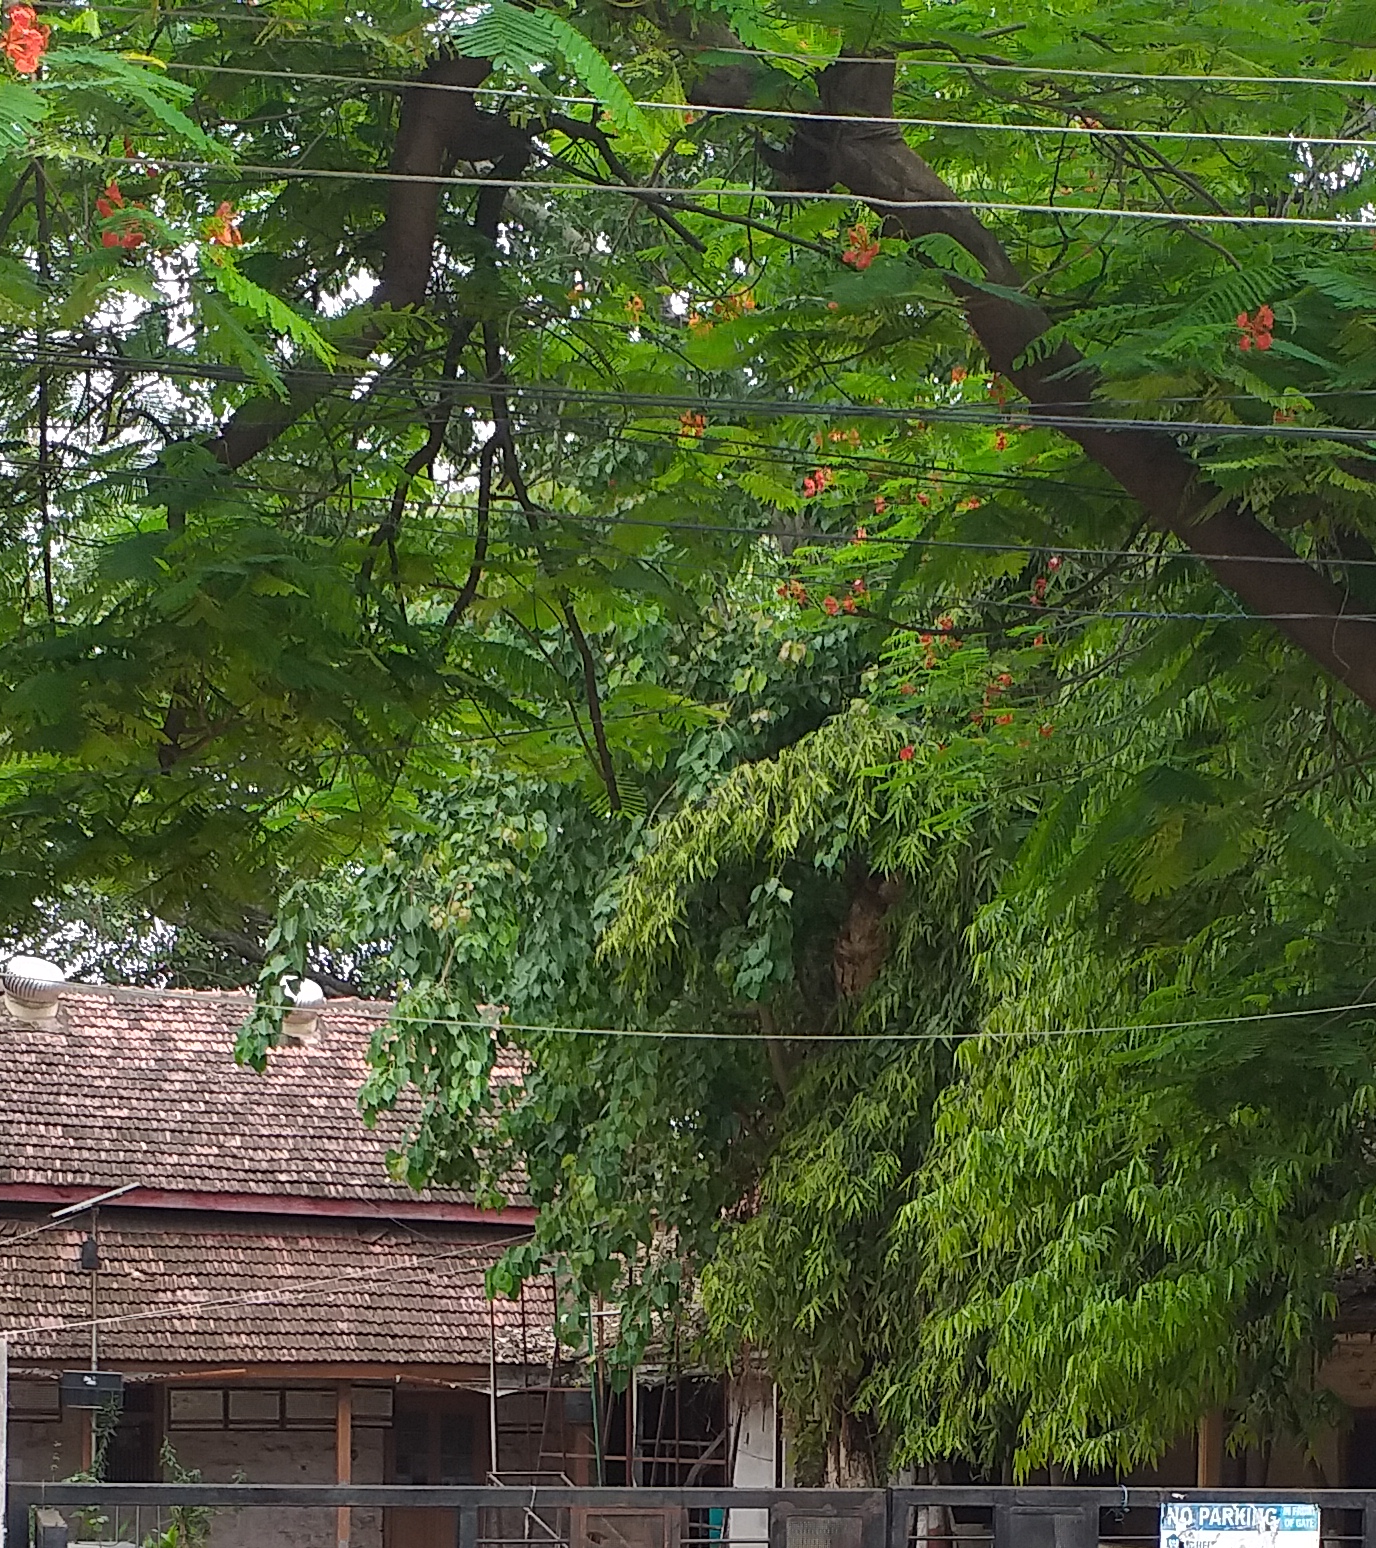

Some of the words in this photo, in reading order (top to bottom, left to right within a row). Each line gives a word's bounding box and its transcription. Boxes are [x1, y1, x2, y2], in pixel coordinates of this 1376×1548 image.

[1166, 1507, 1193, 1526] NO
[1199, 1506, 1279, 1527] PARKING
[1295, 1518, 1316, 1527] GATE
